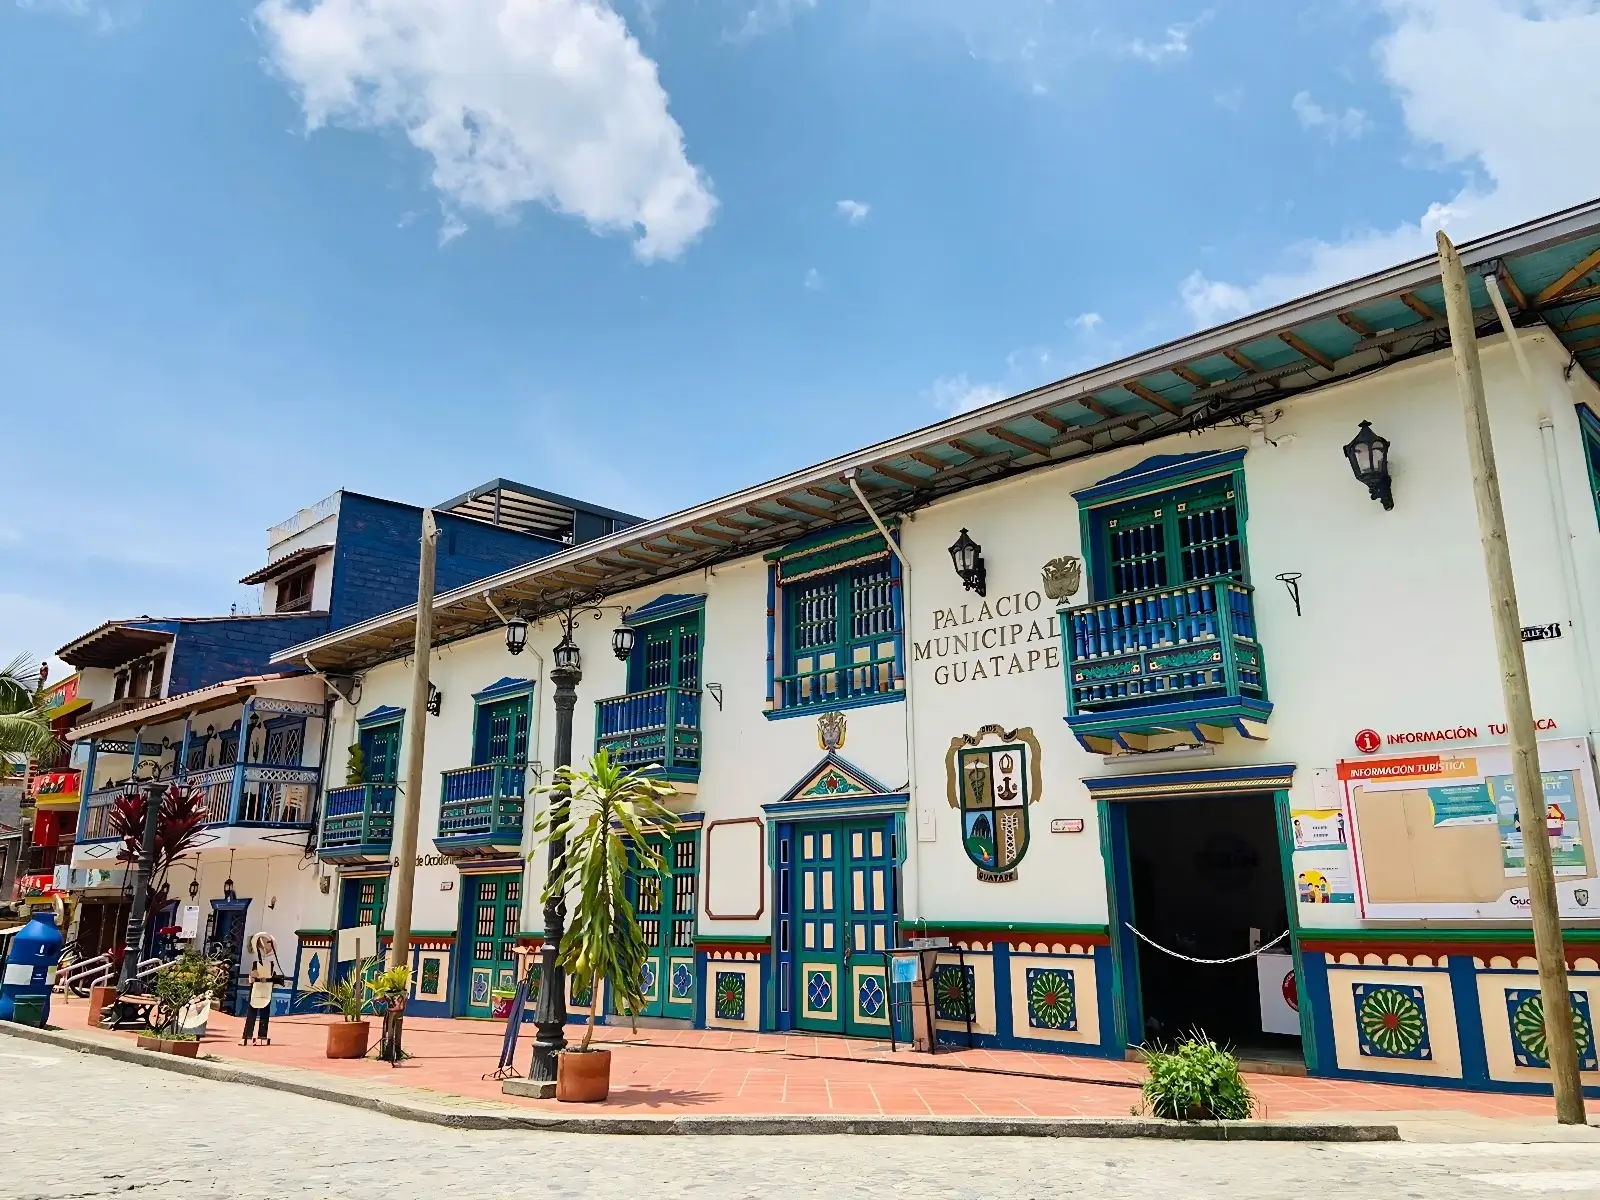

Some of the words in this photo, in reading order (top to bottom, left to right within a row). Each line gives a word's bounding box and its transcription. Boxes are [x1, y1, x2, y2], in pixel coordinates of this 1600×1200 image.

[932, 590, 1042, 631] PALACIO
[913, 616, 1061, 662] MUNICIPAL
[934, 646, 1060, 686] GUATAPE
[1386, 725, 1478, 745] INFORMACIÓN
[1487, 718, 1557, 735] TUICA
[1350, 764, 1415, 778] INFORMACIÓN
[1417, 760, 1466, 773] TURÍSTICA
